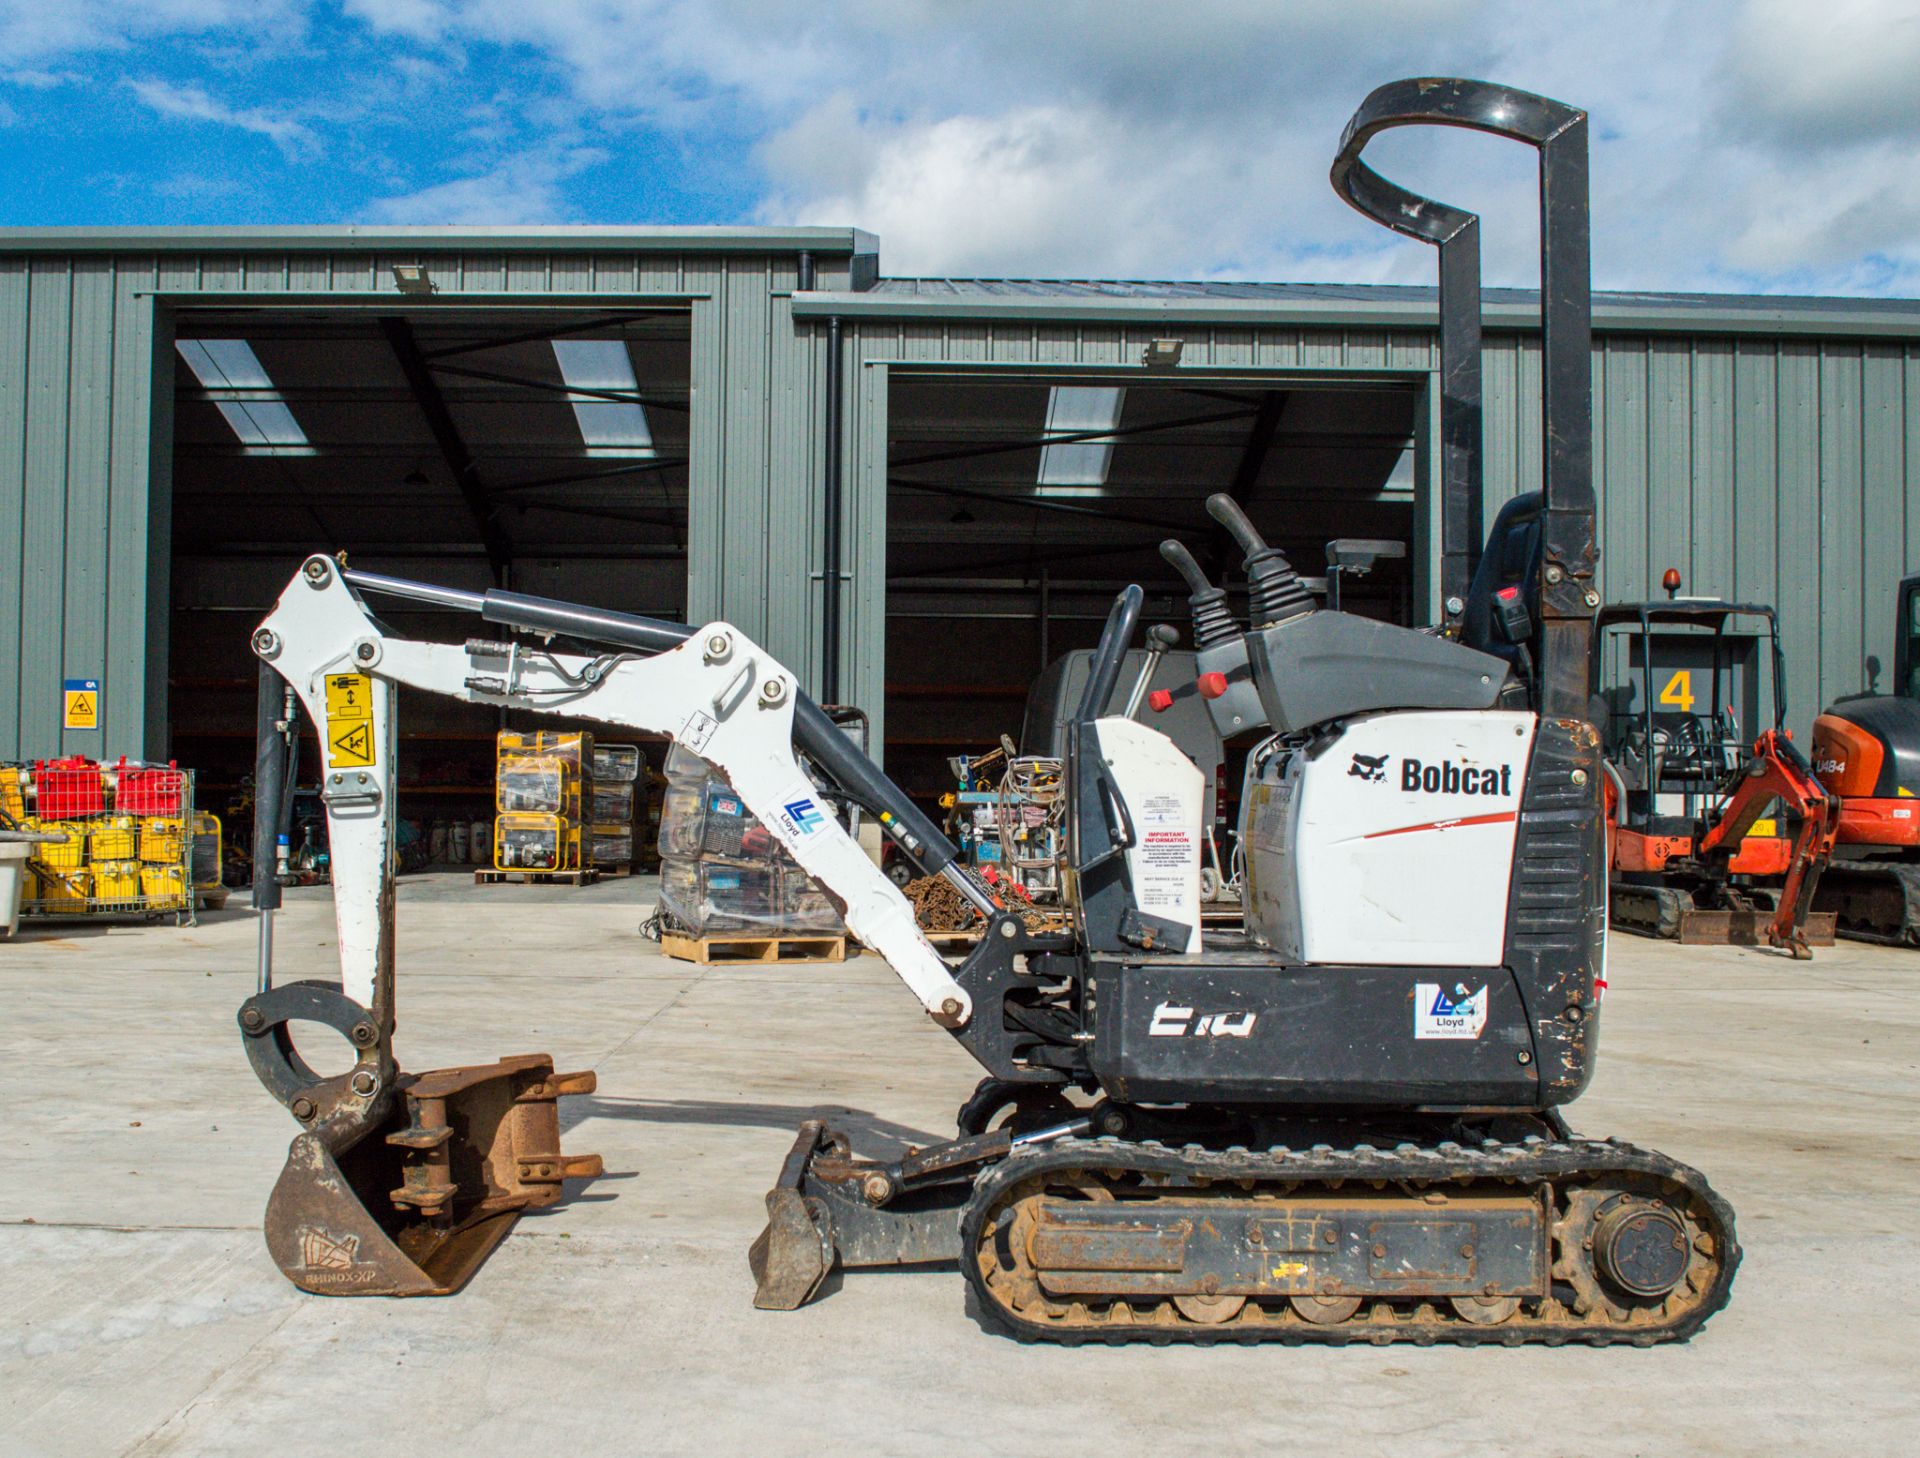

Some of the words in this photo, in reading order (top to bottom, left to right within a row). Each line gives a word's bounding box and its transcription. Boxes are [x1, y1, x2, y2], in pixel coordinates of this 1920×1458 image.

[1660, 670, 1695, 712] 4
[1401, 758, 1511, 796] Bobcat
[780, 813, 800, 836] Lloyd
[1436, 1018, 1464, 1028] Lloyd
